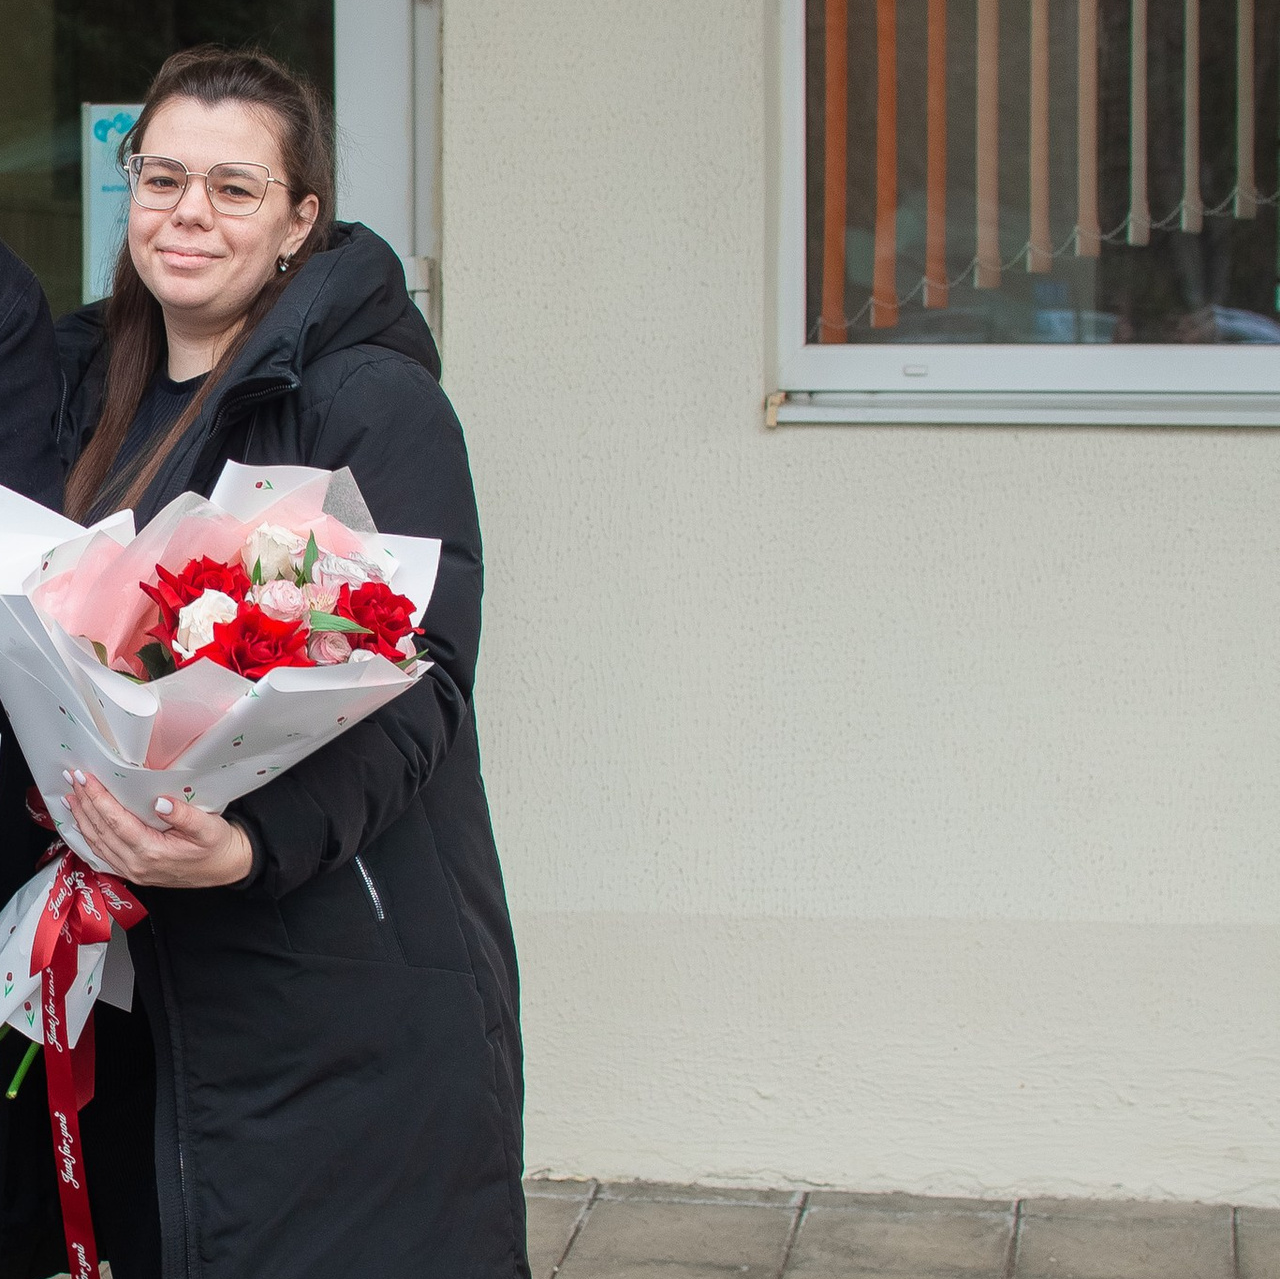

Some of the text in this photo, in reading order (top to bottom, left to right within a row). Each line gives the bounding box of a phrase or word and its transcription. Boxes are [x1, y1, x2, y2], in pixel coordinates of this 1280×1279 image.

[47, 887, 67, 920] Just
[44, 997, 61, 1026] for
[46, 1018, 63, 1054] Just
[57, 1111, 80, 1190] Just for you
[76, 1242, 92, 1272] you
